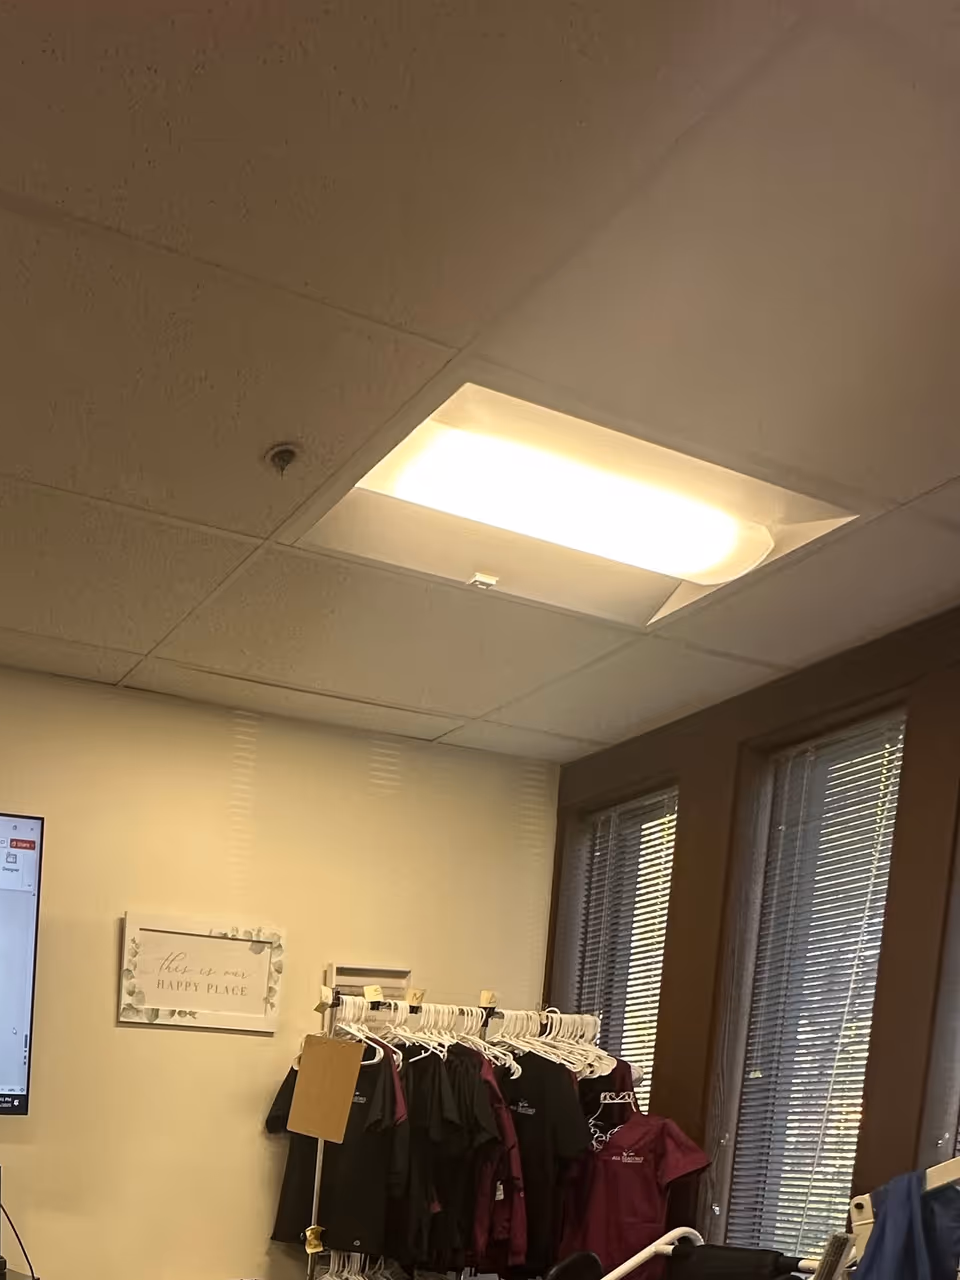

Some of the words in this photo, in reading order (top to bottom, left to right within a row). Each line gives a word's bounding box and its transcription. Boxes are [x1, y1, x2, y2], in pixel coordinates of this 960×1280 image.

[157, 951, 191, 977] this
[199, 969, 216, 977] is
[156, 979, 200, 995] HAPPY
[206, 982, 248, 997] PLACE
